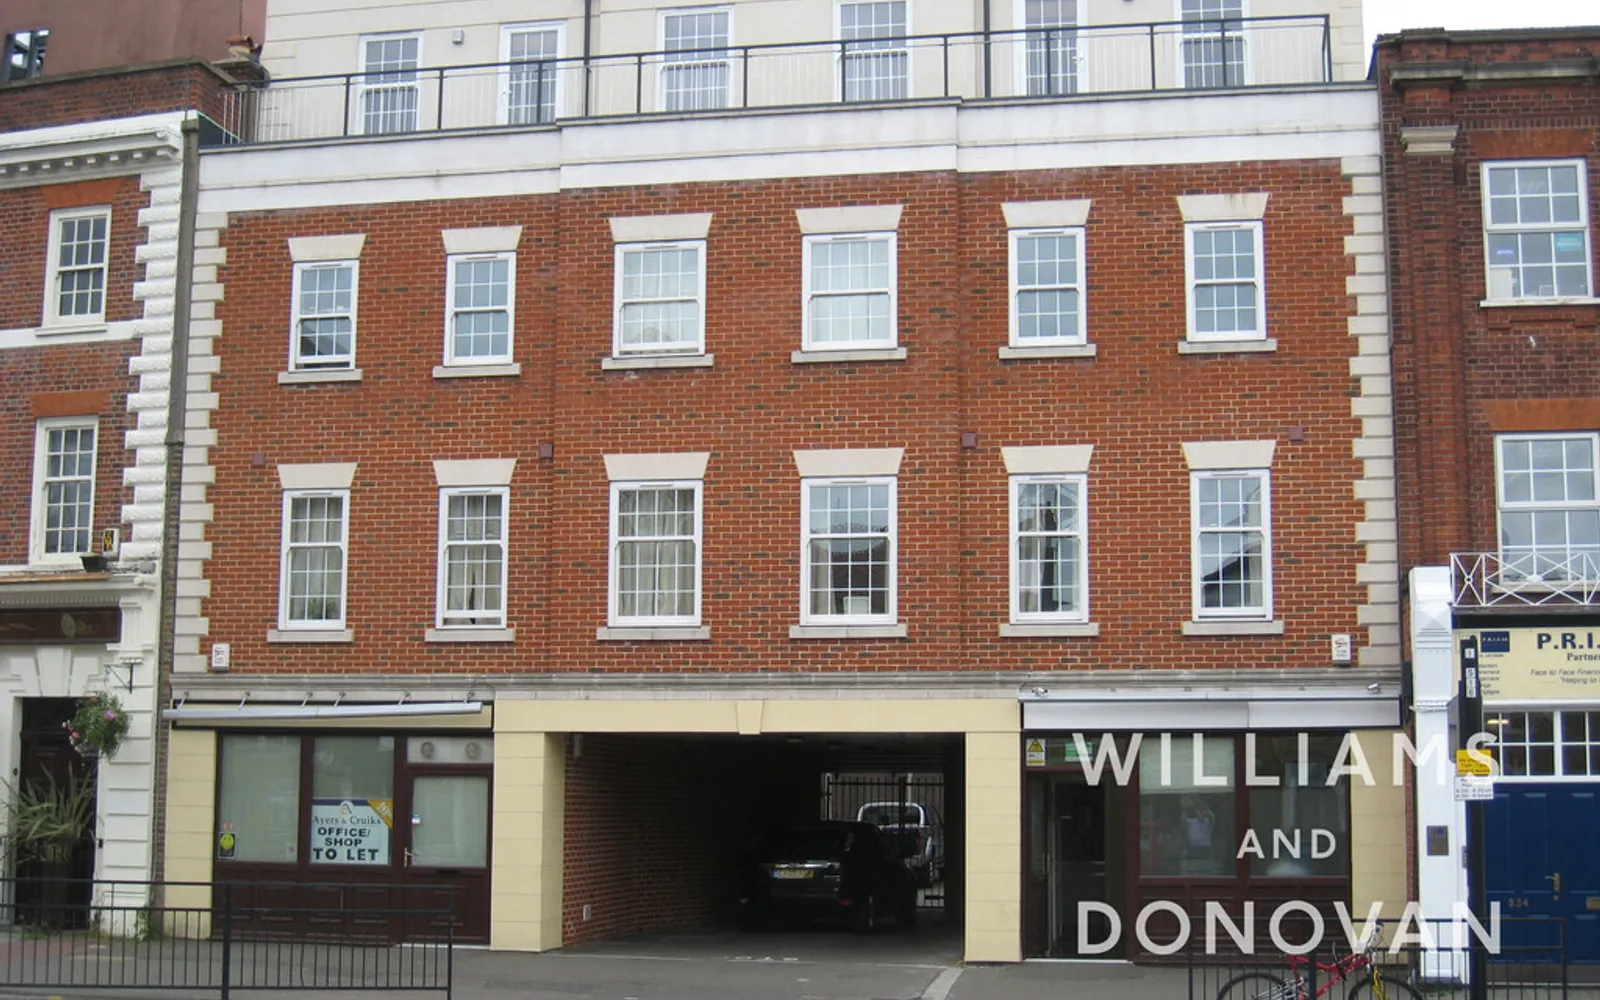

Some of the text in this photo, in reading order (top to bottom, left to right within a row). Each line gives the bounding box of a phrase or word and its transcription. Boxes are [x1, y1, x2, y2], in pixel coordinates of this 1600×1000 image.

[312, 815, 339, 826] Ayers
[317, 826, 371, 837] OFFICE/
[325, 837, 362, 847] SHOP
[312, 848, 379, 861] TO LET
